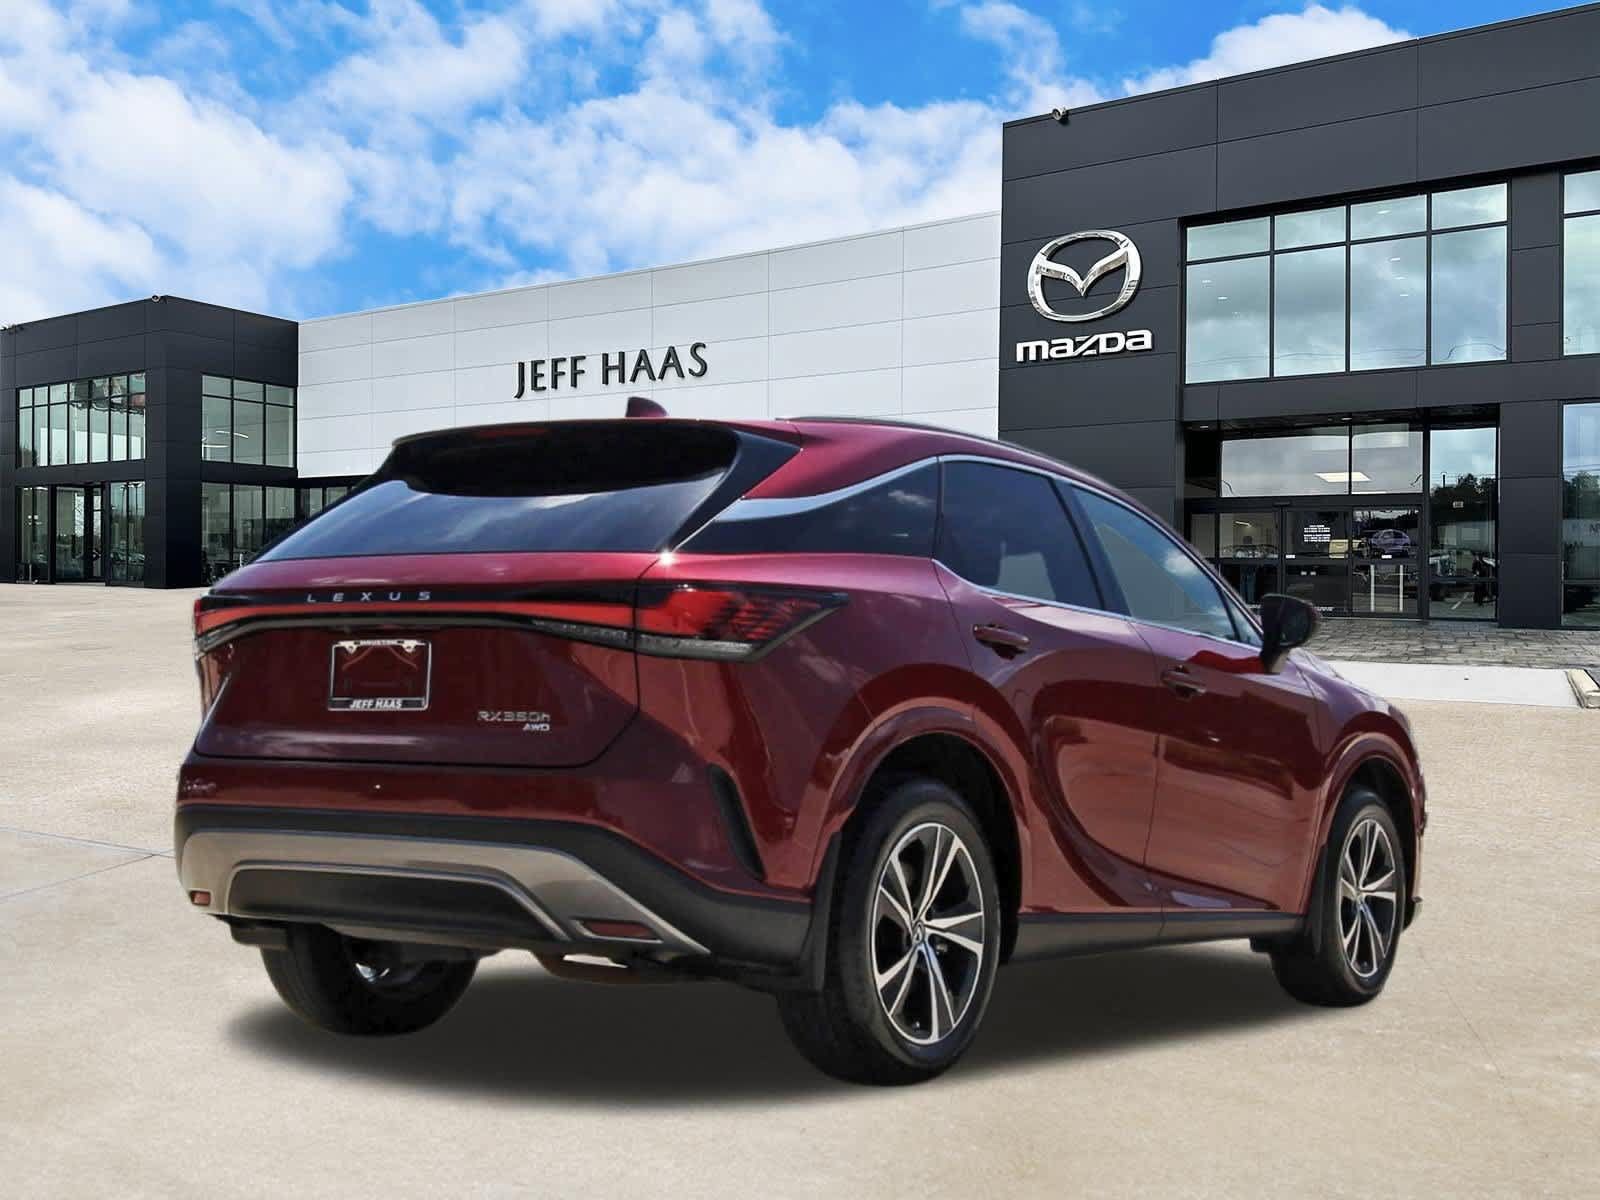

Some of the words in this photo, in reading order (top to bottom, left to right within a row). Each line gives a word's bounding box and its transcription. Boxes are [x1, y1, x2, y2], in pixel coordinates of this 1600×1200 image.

[513, 355, 586, 399] JEFF
[601, 342, 708, 385] HAAS
[306, 591, 431, 602] LEXUS
[349, 699, 374, 709] JEFF
[375, 698, 403, 709] HAAS
[522, 722, 550, 731] AWD
